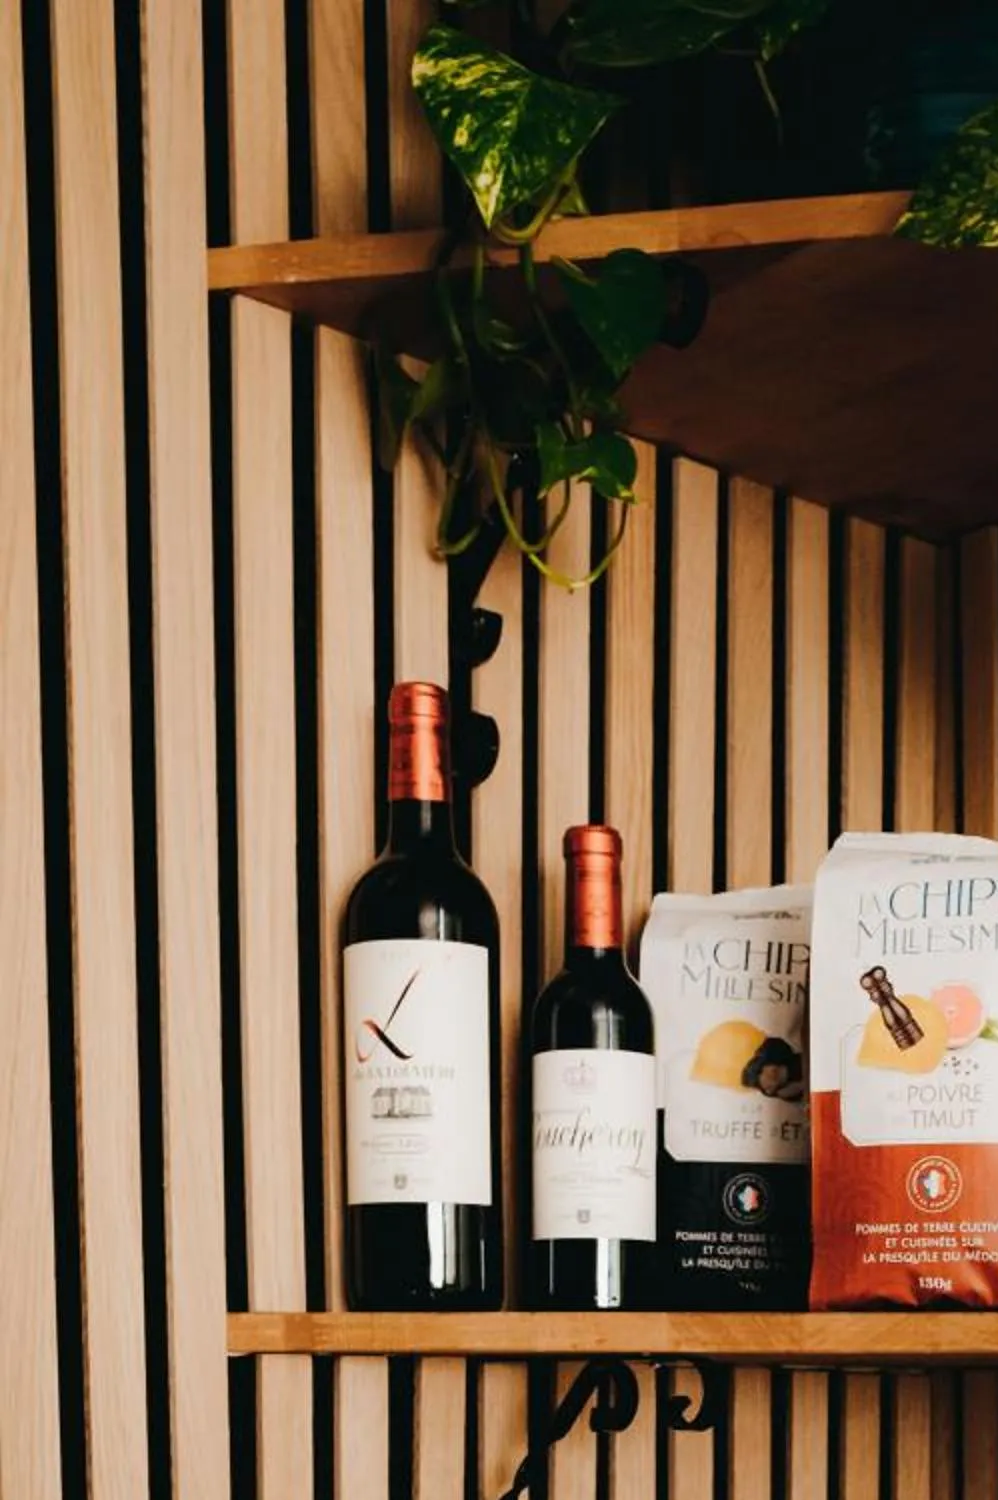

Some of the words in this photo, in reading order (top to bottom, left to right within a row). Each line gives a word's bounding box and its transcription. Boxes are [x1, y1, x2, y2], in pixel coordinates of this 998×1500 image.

[713, 938, 810, 974] CHIP
[680, 964, 809, 1003] MILLESI
[907, 1083, 983, 1104] POIVRE
[690, 1120, 763, 1139] TRUFFE
[910, 1109, 977, 1129] TIMUT
